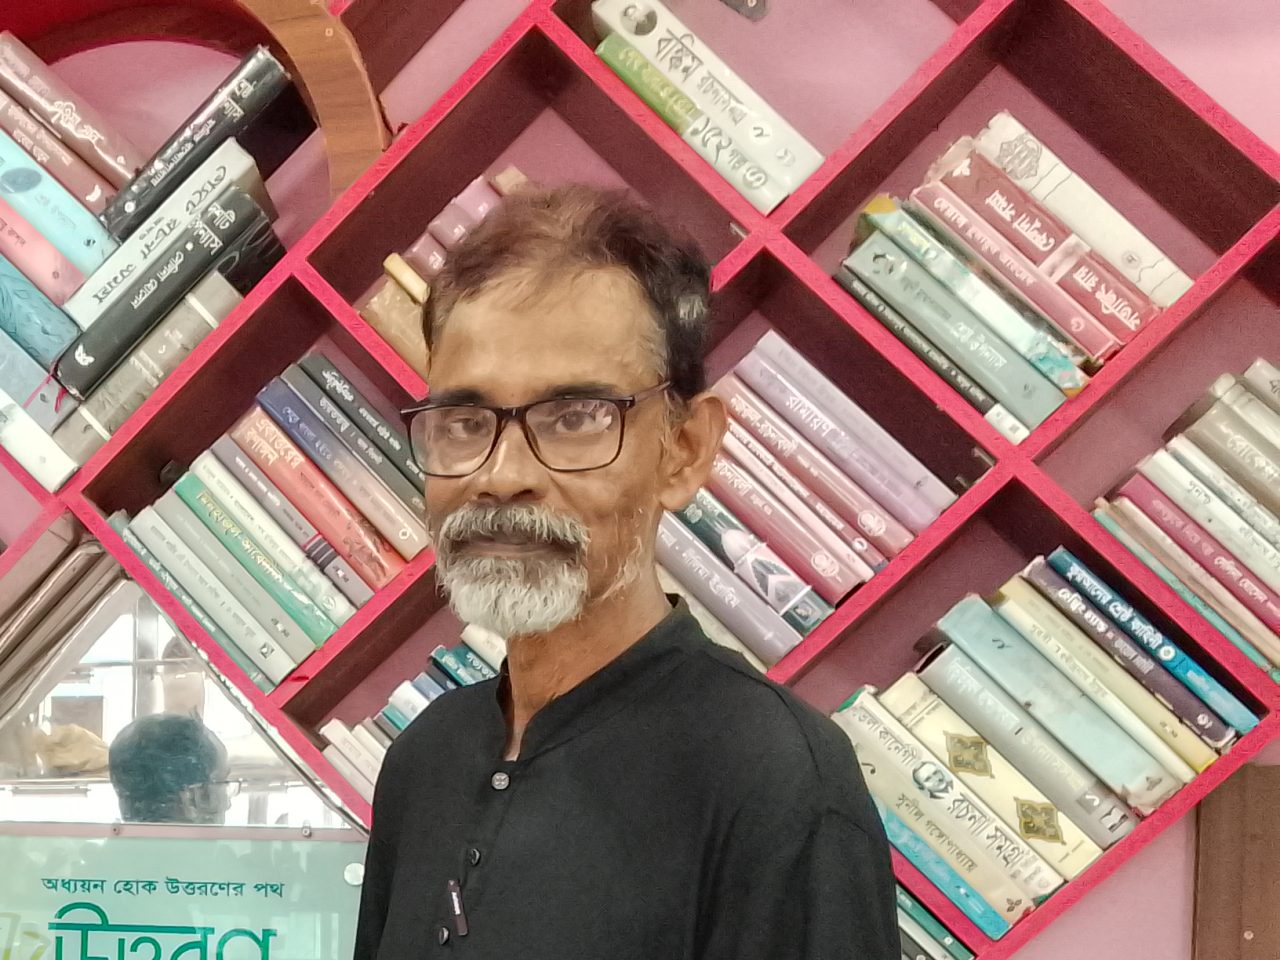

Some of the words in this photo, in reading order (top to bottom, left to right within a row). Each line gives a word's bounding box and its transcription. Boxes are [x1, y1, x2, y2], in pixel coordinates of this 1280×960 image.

[135, 214, 182, 260] রচনা
[90, 259, 137, 305] সমগ্র
[1070, 263, 1101, 293] রায়
[1088, 281, 1145, 336] সত্যজিৎ
[893, 790, 927, 824] সুনীল
[944, 790, 993, 838] রচনা
[979, 823, 1030, 873] সমগ্র
[41, 876, 107, 896] অধ্যয়ন
[114, 877, 158, 896] হোক
[165, 876, 245, 898] উত্তরণের
[253, 882, 285, 899] পথ
